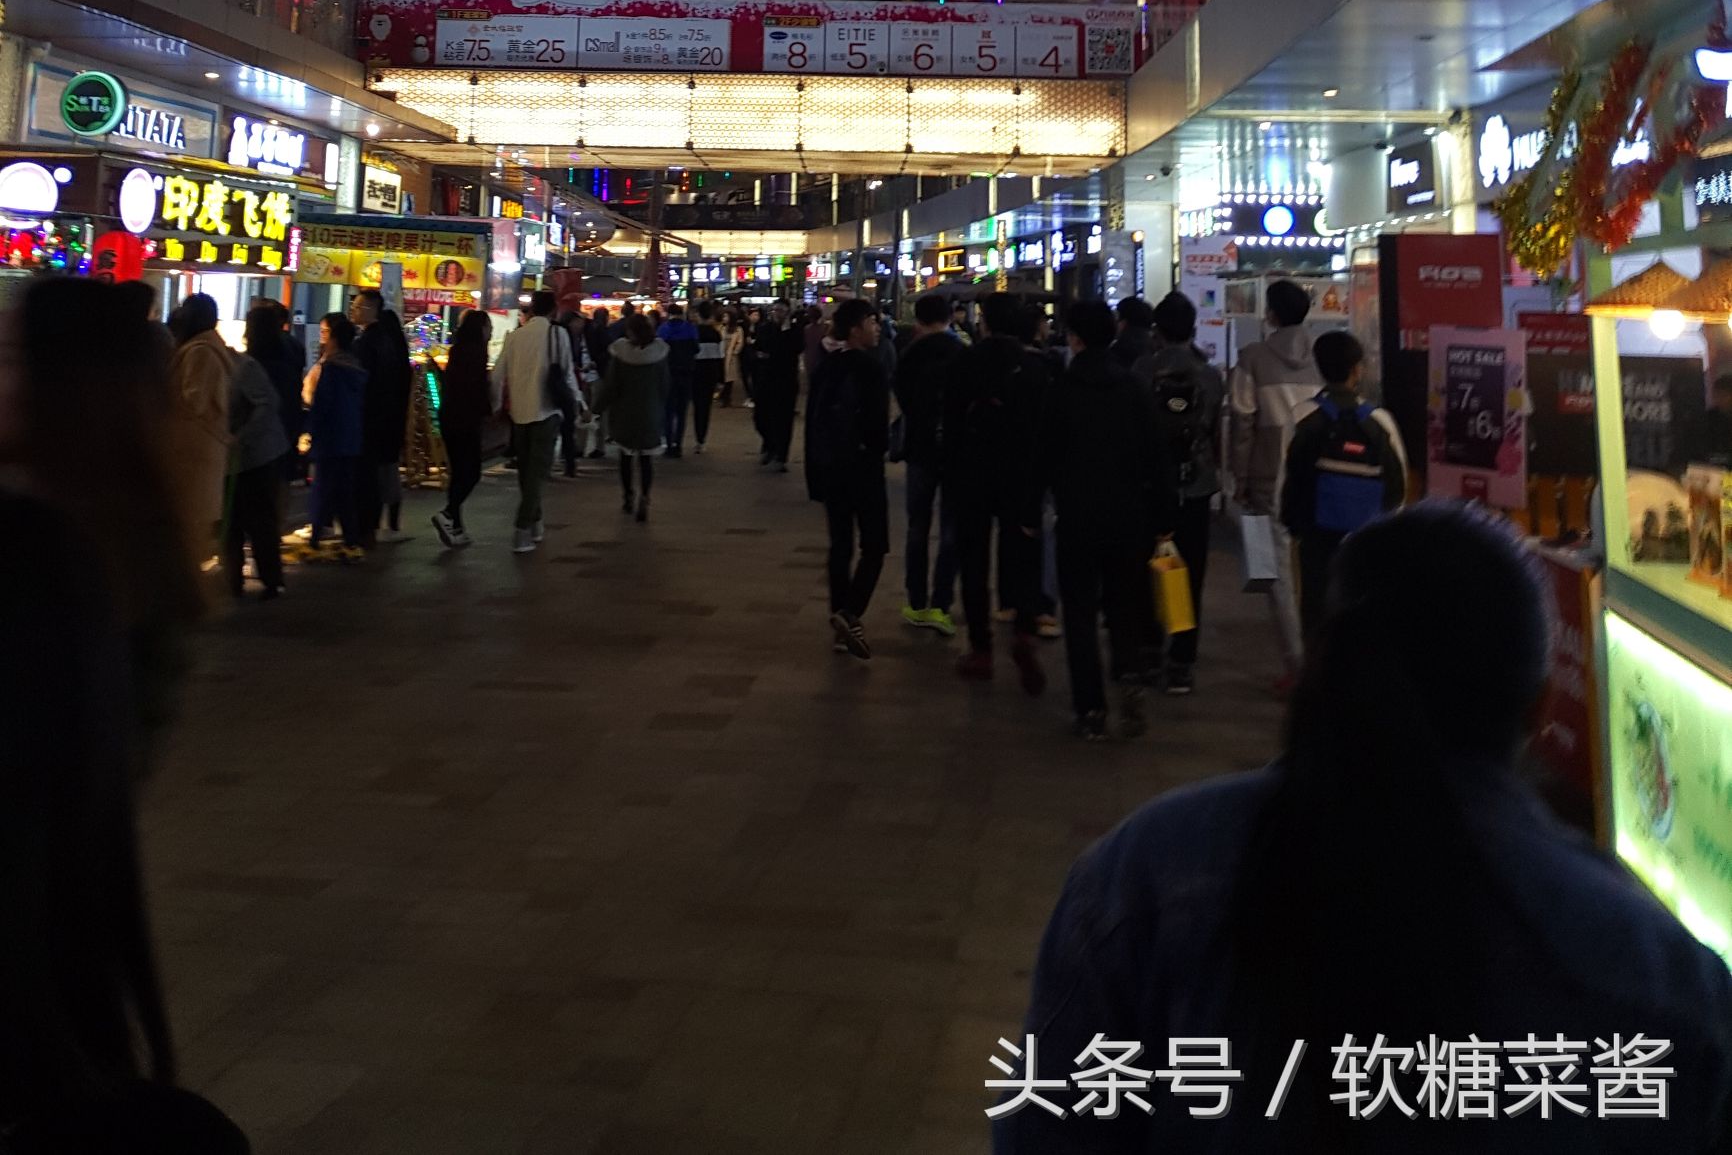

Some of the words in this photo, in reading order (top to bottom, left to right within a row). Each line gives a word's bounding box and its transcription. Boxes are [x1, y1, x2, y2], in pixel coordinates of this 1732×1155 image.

[536, 39, 565, 64] 25
[699, 47, 723, 66] 20
[788, 42, 807, 69] 8
[847, 43, 867, 69] 5
[914, 43, 934, 71] 6
[976, 45, 997, 72] 5
[1039, 46, 1062, 73] 4
[162, 175, 291, 241] 印度飞饼
